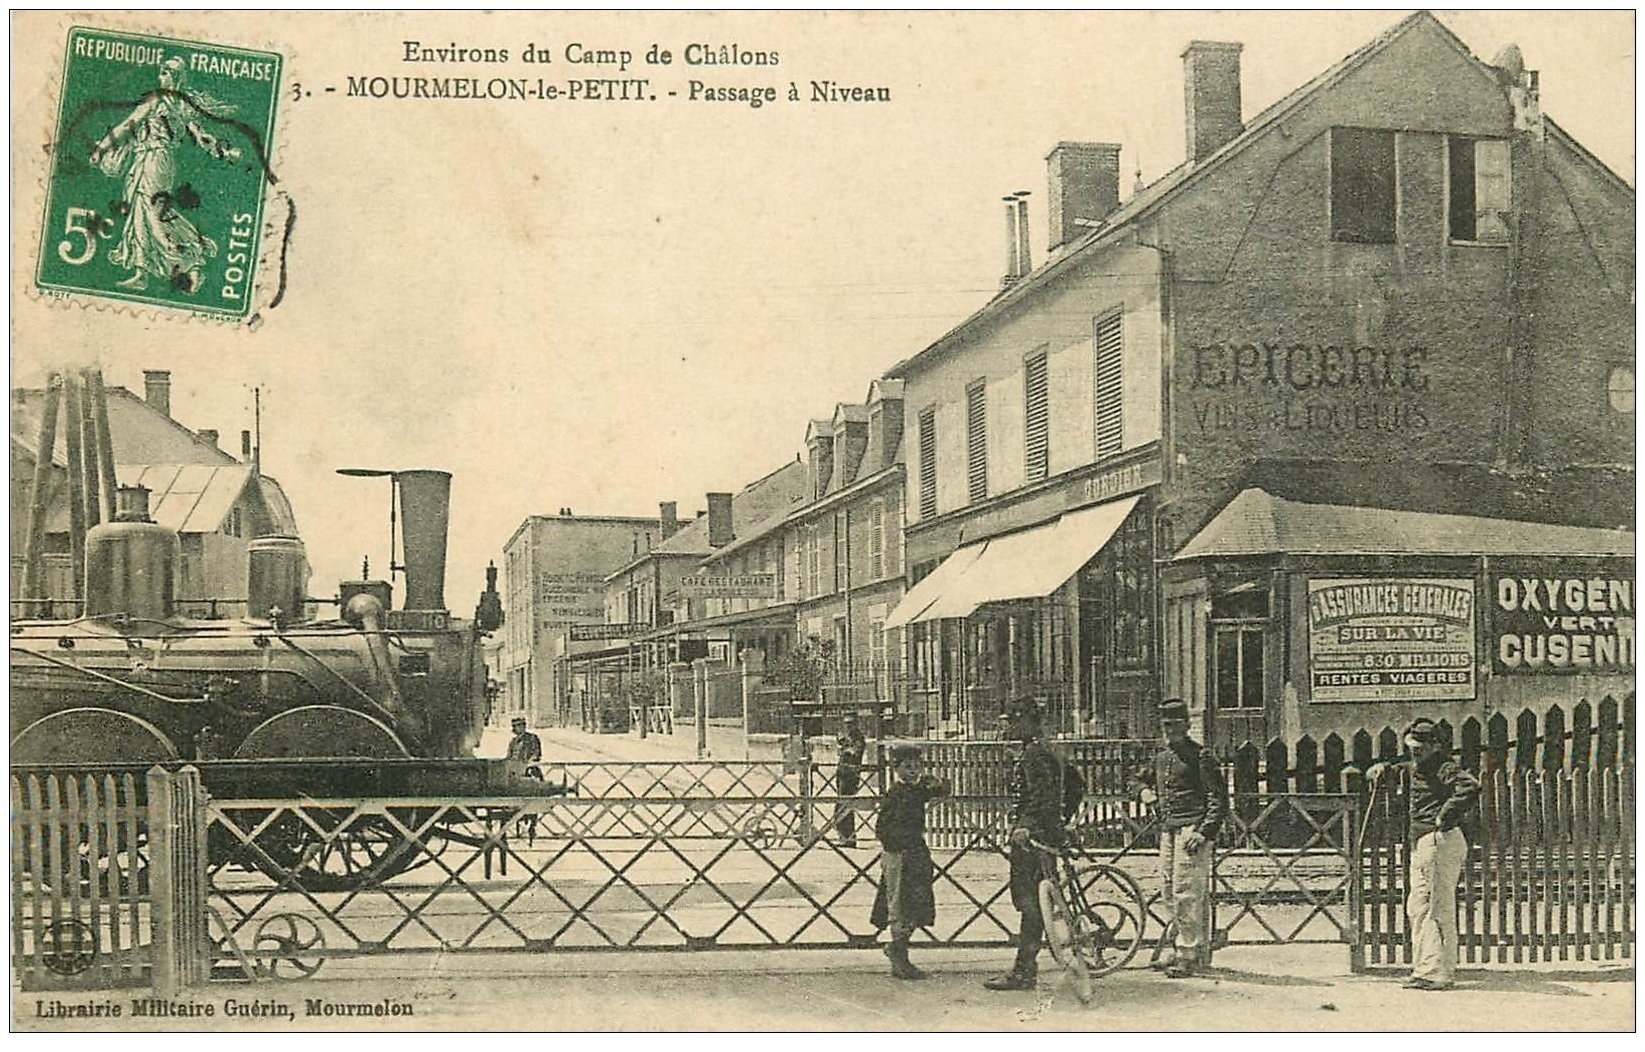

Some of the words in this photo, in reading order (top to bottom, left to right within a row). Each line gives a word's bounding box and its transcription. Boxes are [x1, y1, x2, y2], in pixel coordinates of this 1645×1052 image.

[190, 52, 272, 82] FRANÇAISE
[222, 212, 252, 299] POSTES
[1341, 626, 1378, 641] SUR
[1385, 626, 1410, 640] LA
[1413, 625, 1446, 640] VIE
[1364, 654, 1395, 667] 830
[1400, 653, 1470, 667] MILLIONS
[1499, 633, 1635, 668] CUSENI
[1319, 673, 1382, 686] RENTES
